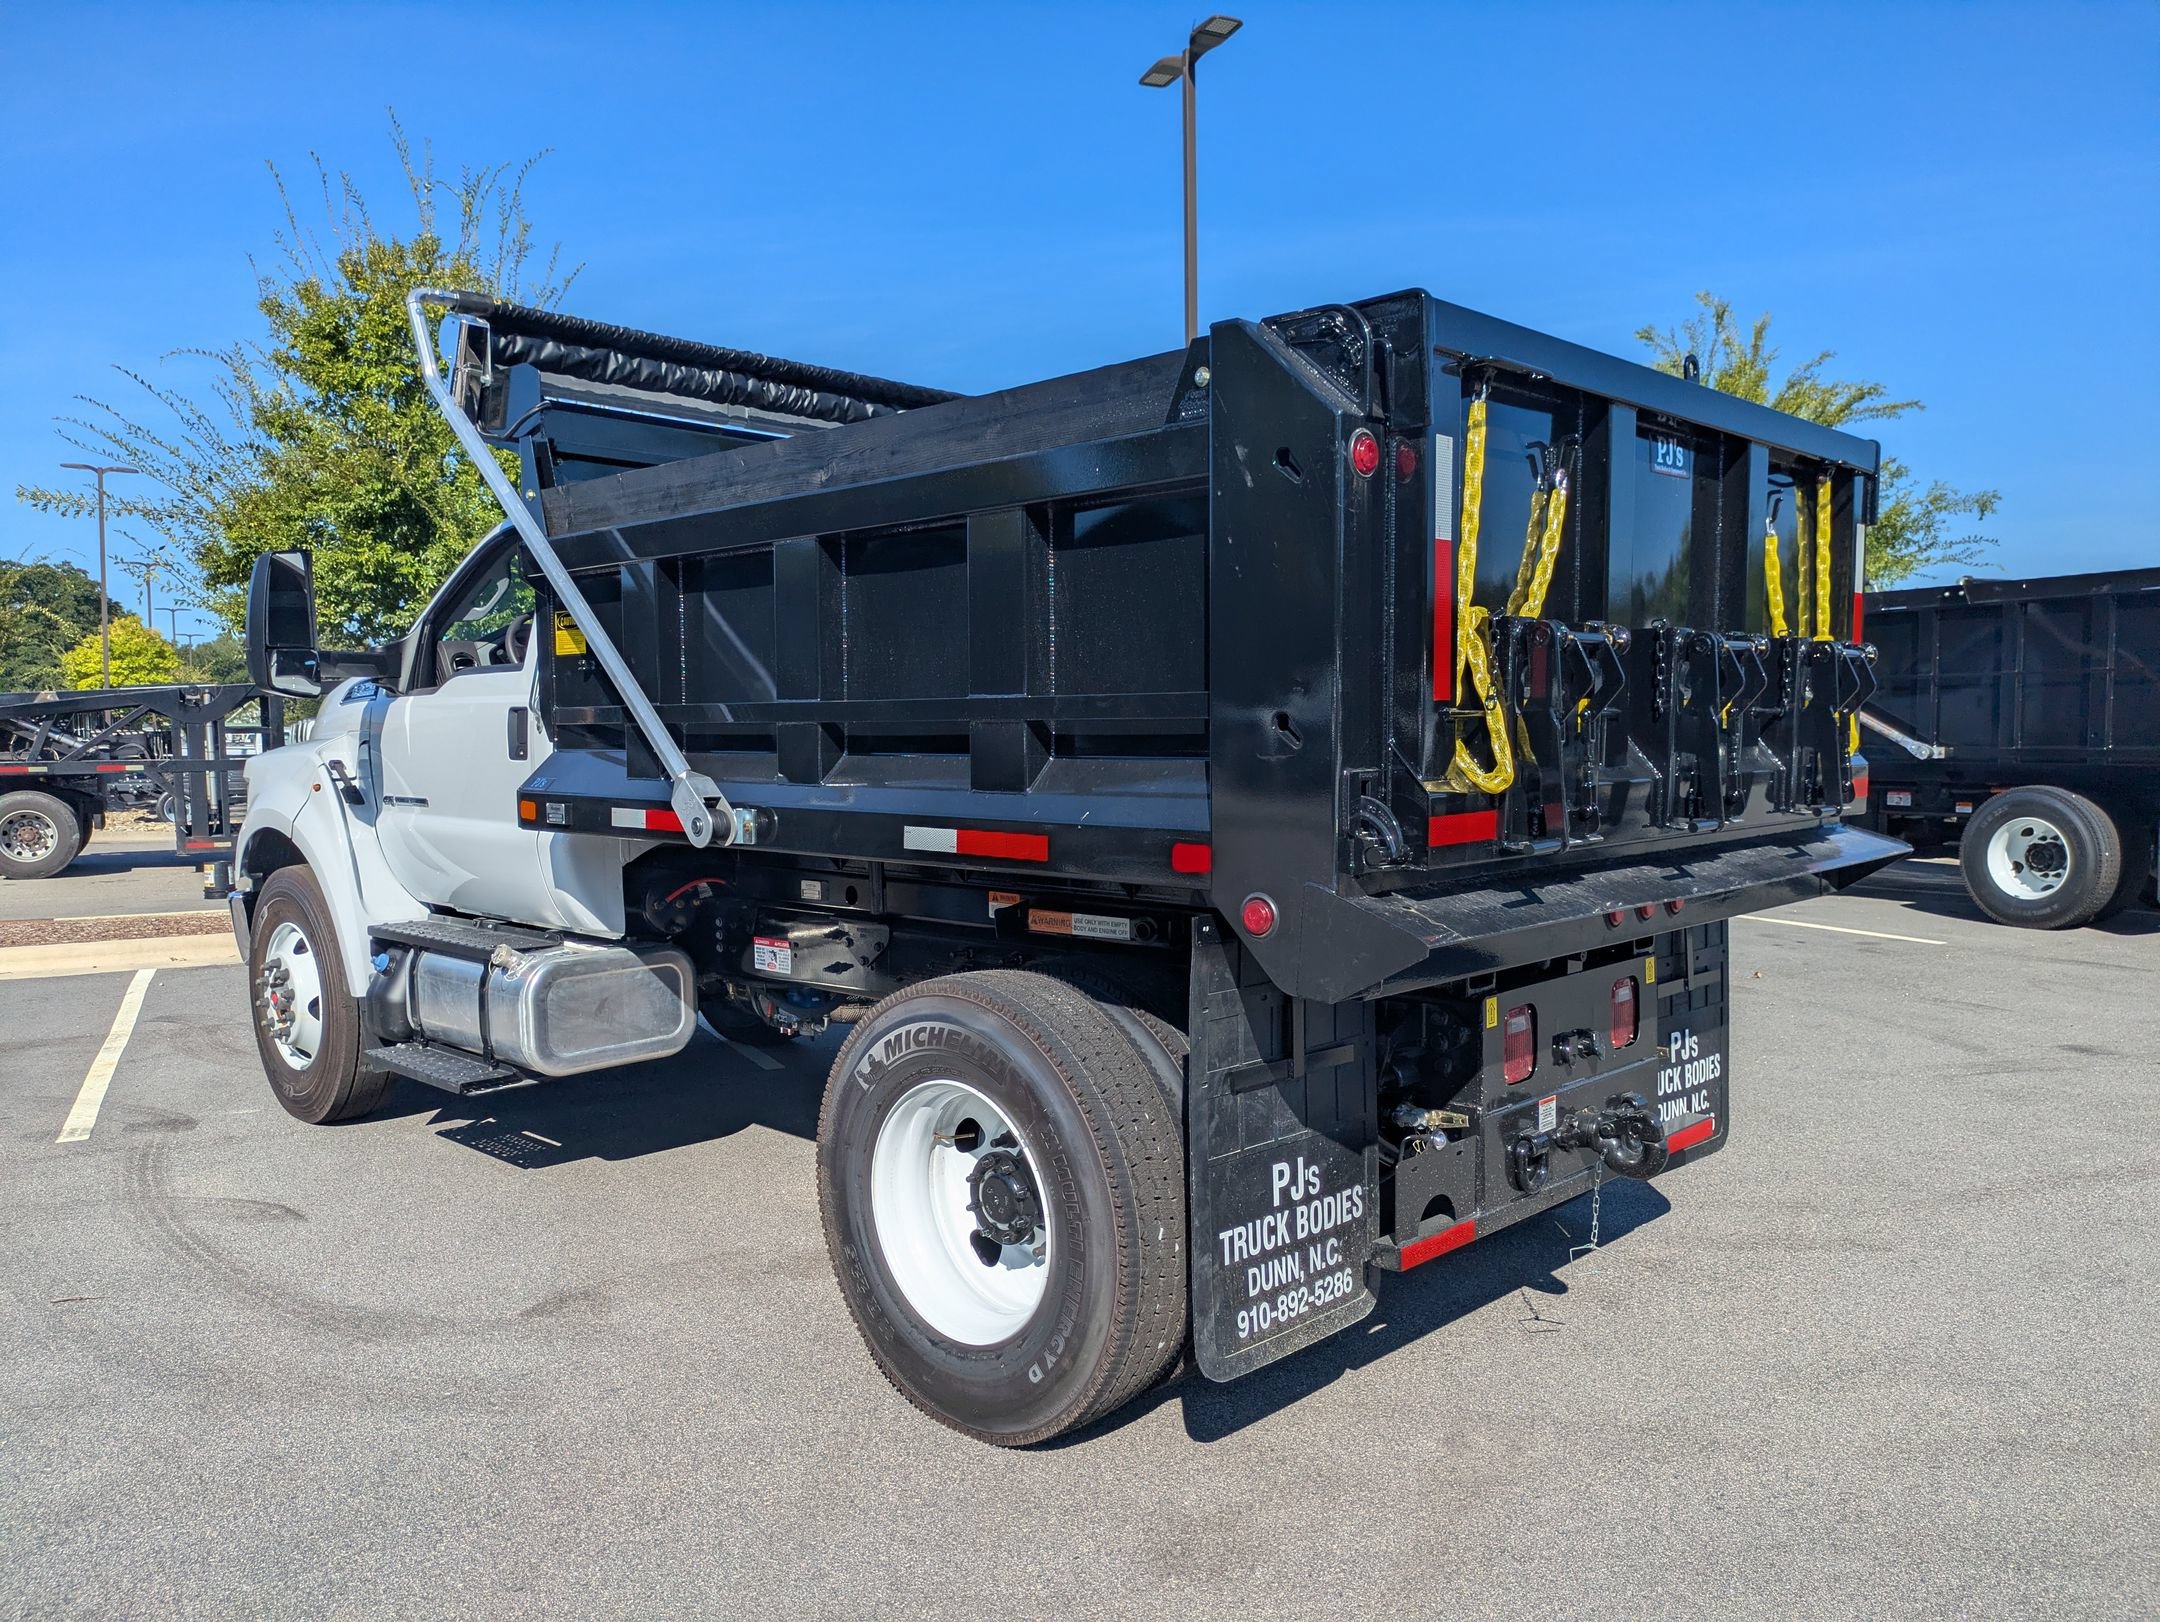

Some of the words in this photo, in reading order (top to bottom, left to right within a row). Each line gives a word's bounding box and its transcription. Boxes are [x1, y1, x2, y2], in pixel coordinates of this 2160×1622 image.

[1037, 916, 1072, 928] WARNING
[1073, 917, 1085, 925] USE
[1085, 918, 1097, 926] ONLY
[1097, 919, 1111, 927] WITH
[1111, 921, 1128, 929] EMPTY
[1073, 924, 1087, 932] BODY
[1098, 927, 1117, 935] ENGINE
[884, 1026, 1010, 1088] MICHELIN
[1658, 1066, 1682, 1096] UCK
[1685, 1053, 1721, 1089] BODIES
[1691, 1089, 1710, 1113] N.C.
[1052, 1153, 1084, 1252] MULTI
[1219, 1209, 1291, 1266] TRUCK
[1296, 1184, 1363, 1240] BODIES
[1248, 1251, 1304, 1297] DUNN,
[1309, 1237, 1343, 1274] N.C.
[1044, 1258, 1084, 1370] ENERGY
[1237, 1268, 1353, 1339] 910-892-5286
[1028, 1361, 1045, 1383] D
